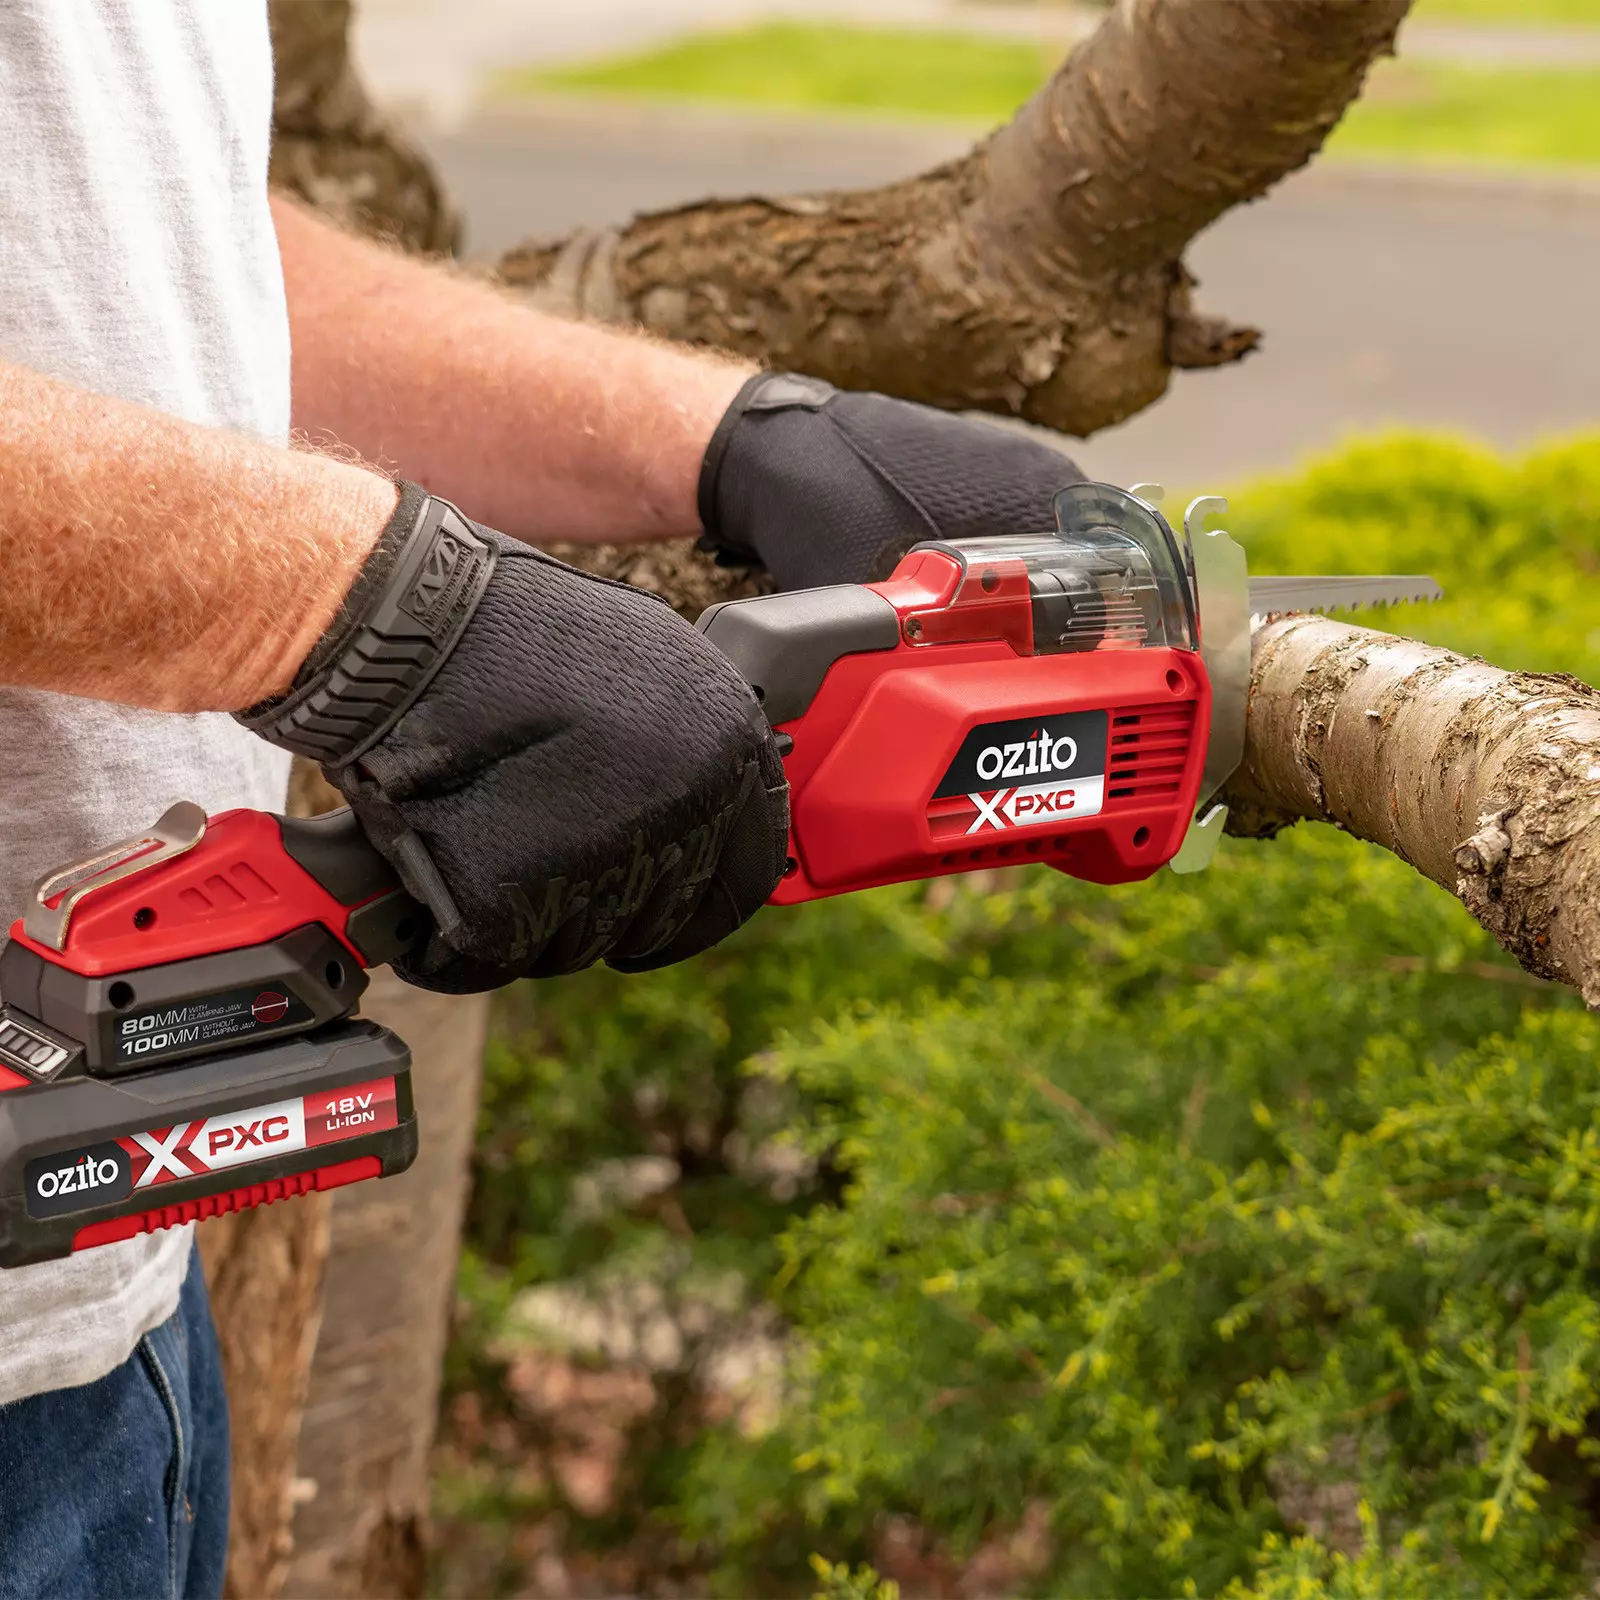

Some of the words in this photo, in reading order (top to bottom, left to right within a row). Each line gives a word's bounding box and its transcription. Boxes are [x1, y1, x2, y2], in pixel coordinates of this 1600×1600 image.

[976, 728, 1078, 781] ozito
[1014, 789, 1076, 817] PXC
[188, 1004, 208, 1014] WITH
[188, 1007, 225, 1021] CLAMPING
[225, 1003, 242, 1012] JAW
[122, 1007, 187, 1035] 80MM
[202, 1019, 235, 1032] WITHOUT
[202, 1025, 239, 1039] CLAMPING
[239, 1021, 257, 1031] JAW
[122, 1026, 199, 1055] 100MM
[325, 1093, 374, 1116] 18V
[326, 1110, 375, 1131] LI-ION
[36, 1155, 119, 1198] ozito
[208, 1115, 290, 1157] PXC
